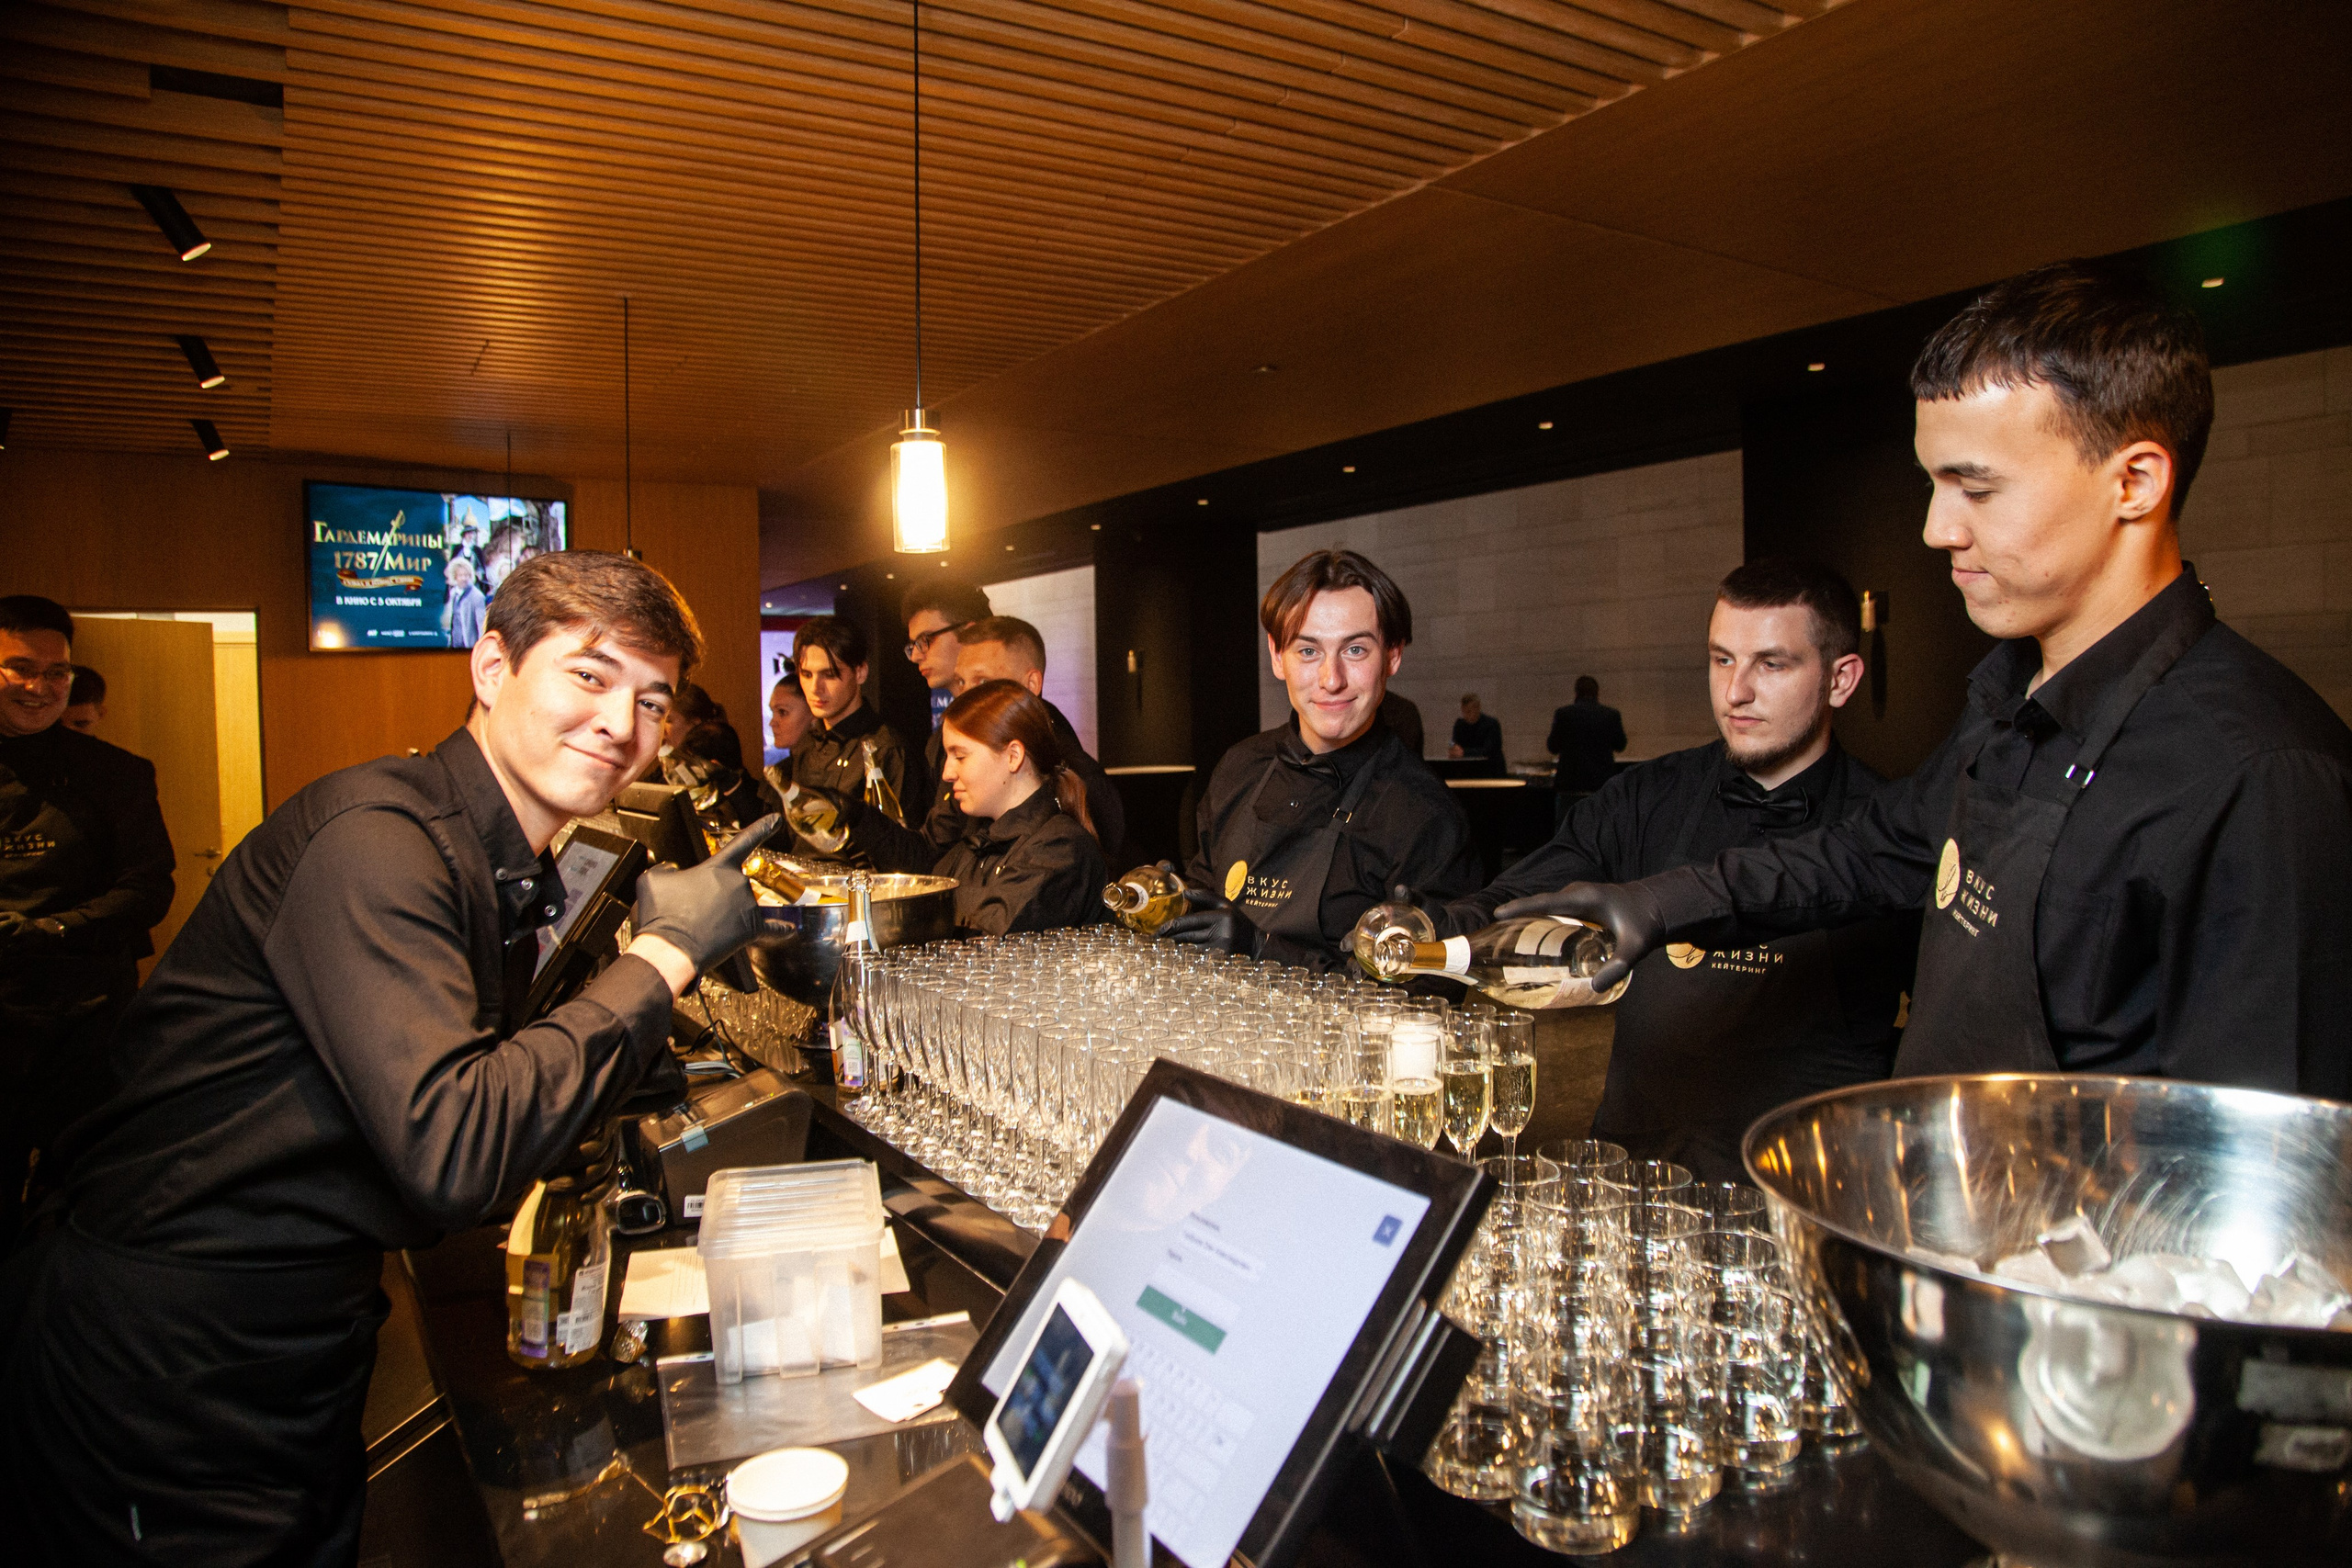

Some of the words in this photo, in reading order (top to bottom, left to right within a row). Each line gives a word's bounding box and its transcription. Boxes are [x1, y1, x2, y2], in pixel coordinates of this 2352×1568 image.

[334, 550, 379, 570] 1787
[335, 595, 344, 605] В
[344, 595, 369, 606] КИНО
[369, 596, 378, 607] С
[1247, 875, 1288, 889] ВКУС
[1246, 886, 1293, 899] ЖИЗНИ
[1711, 962, 1767, 975] КЕЙТЕРИНГ
